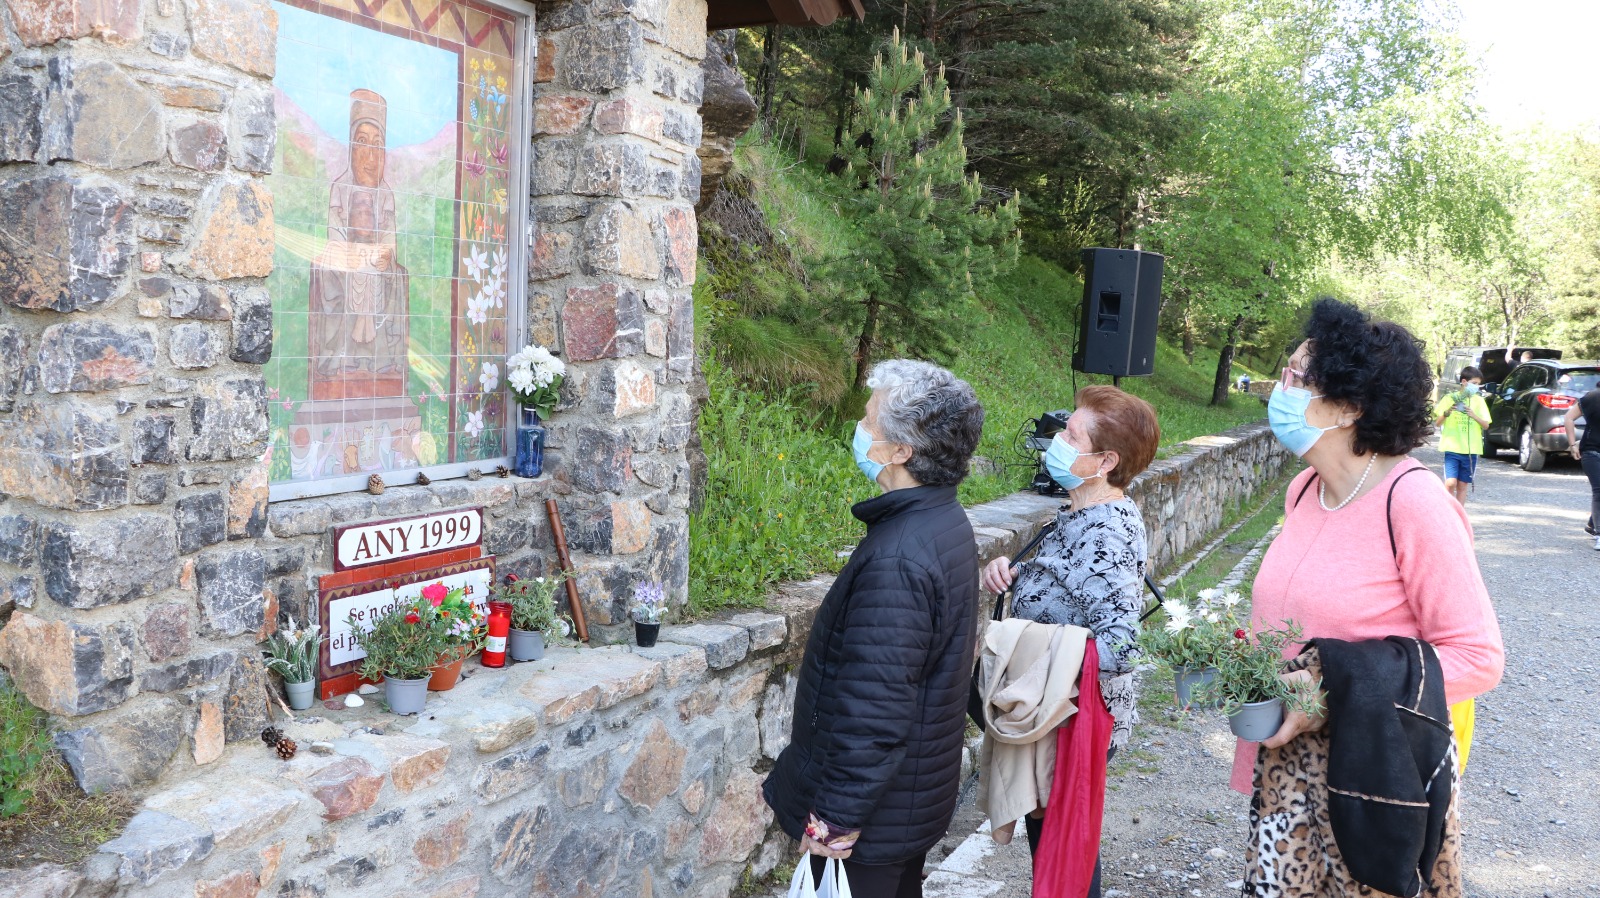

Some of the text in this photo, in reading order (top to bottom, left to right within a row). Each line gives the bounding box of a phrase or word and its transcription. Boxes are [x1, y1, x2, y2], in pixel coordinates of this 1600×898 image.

[352, 515, 471, 562] ANY 1999
[332, 632, 345, 650] el
